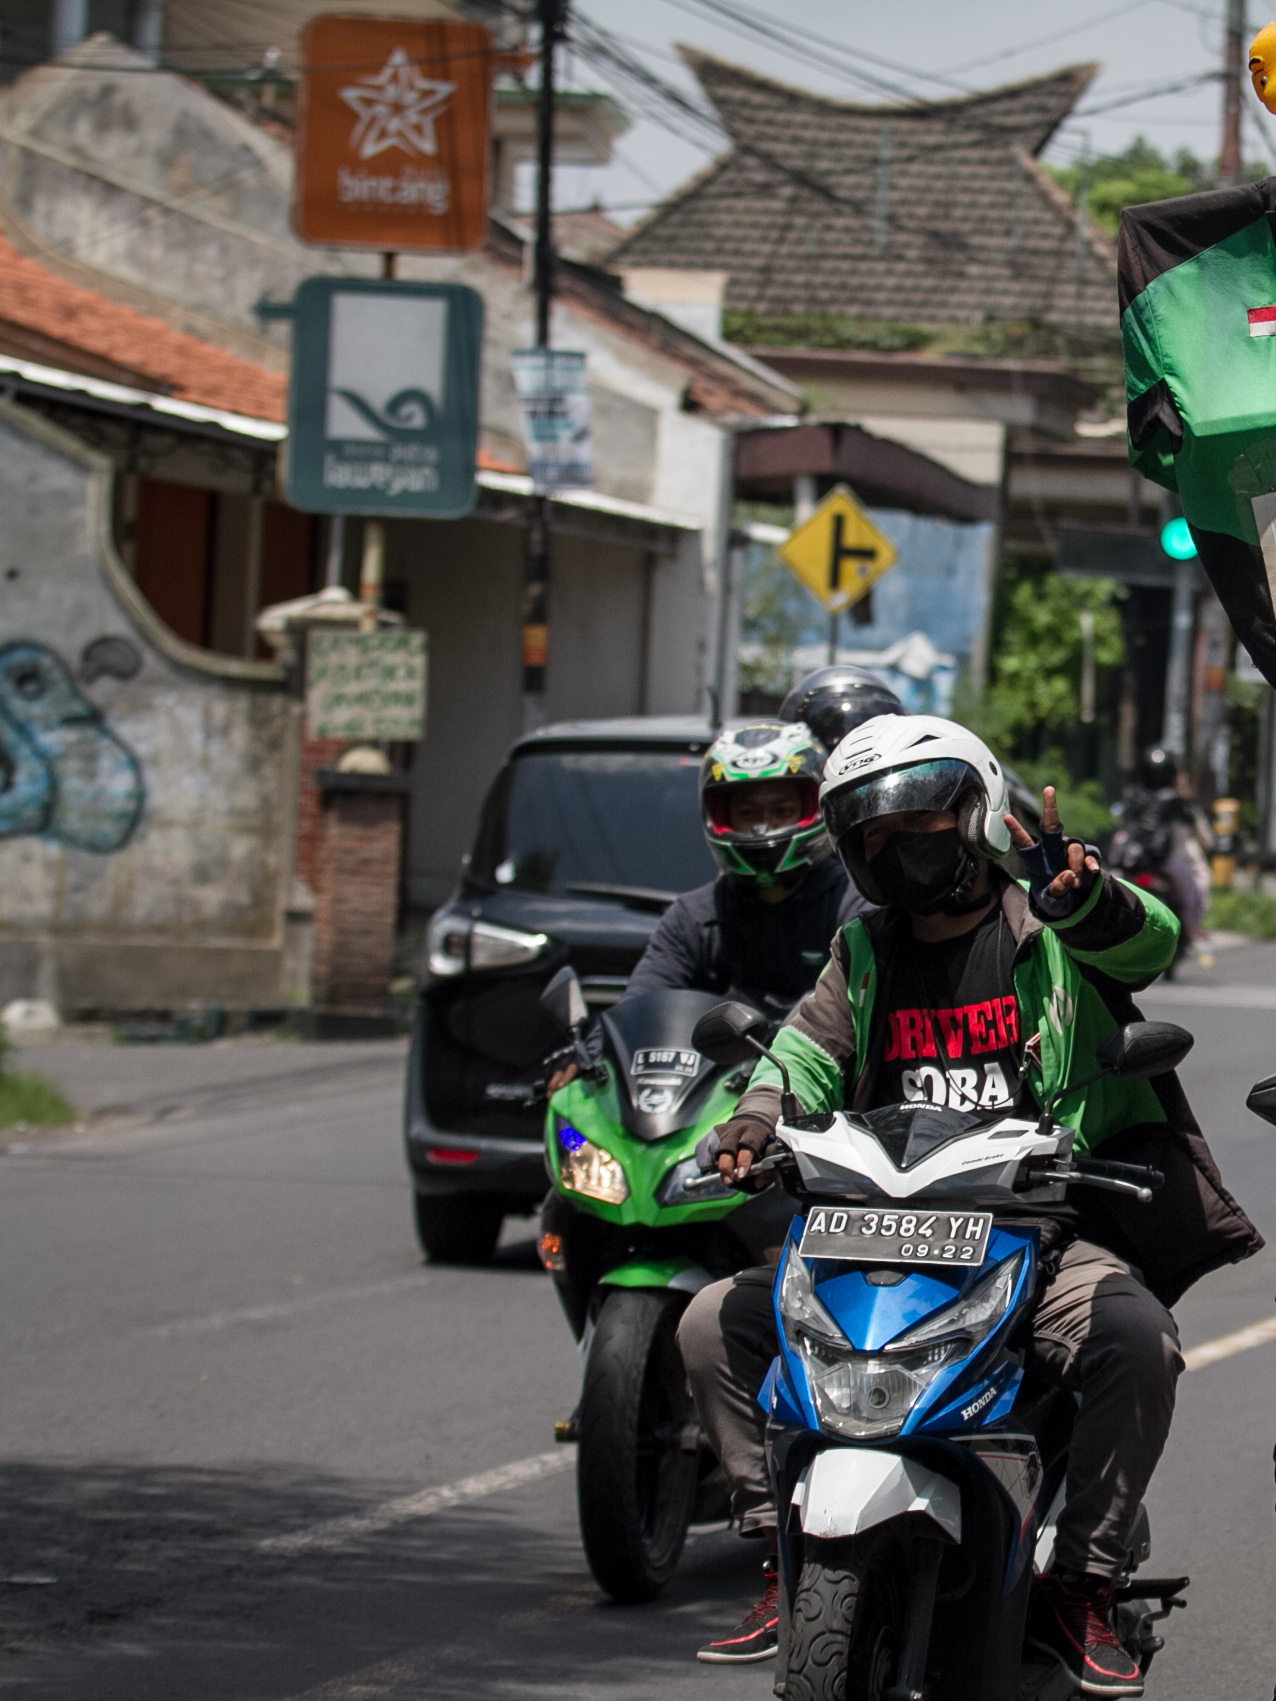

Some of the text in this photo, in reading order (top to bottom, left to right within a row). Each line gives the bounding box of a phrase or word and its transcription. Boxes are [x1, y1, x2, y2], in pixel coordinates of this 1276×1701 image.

[899, 1103, 943, 1112] HONDA
[810, 1212, 984, 1240] AD 3584 YH
[960, 1387, 998, 1421] HONDA
